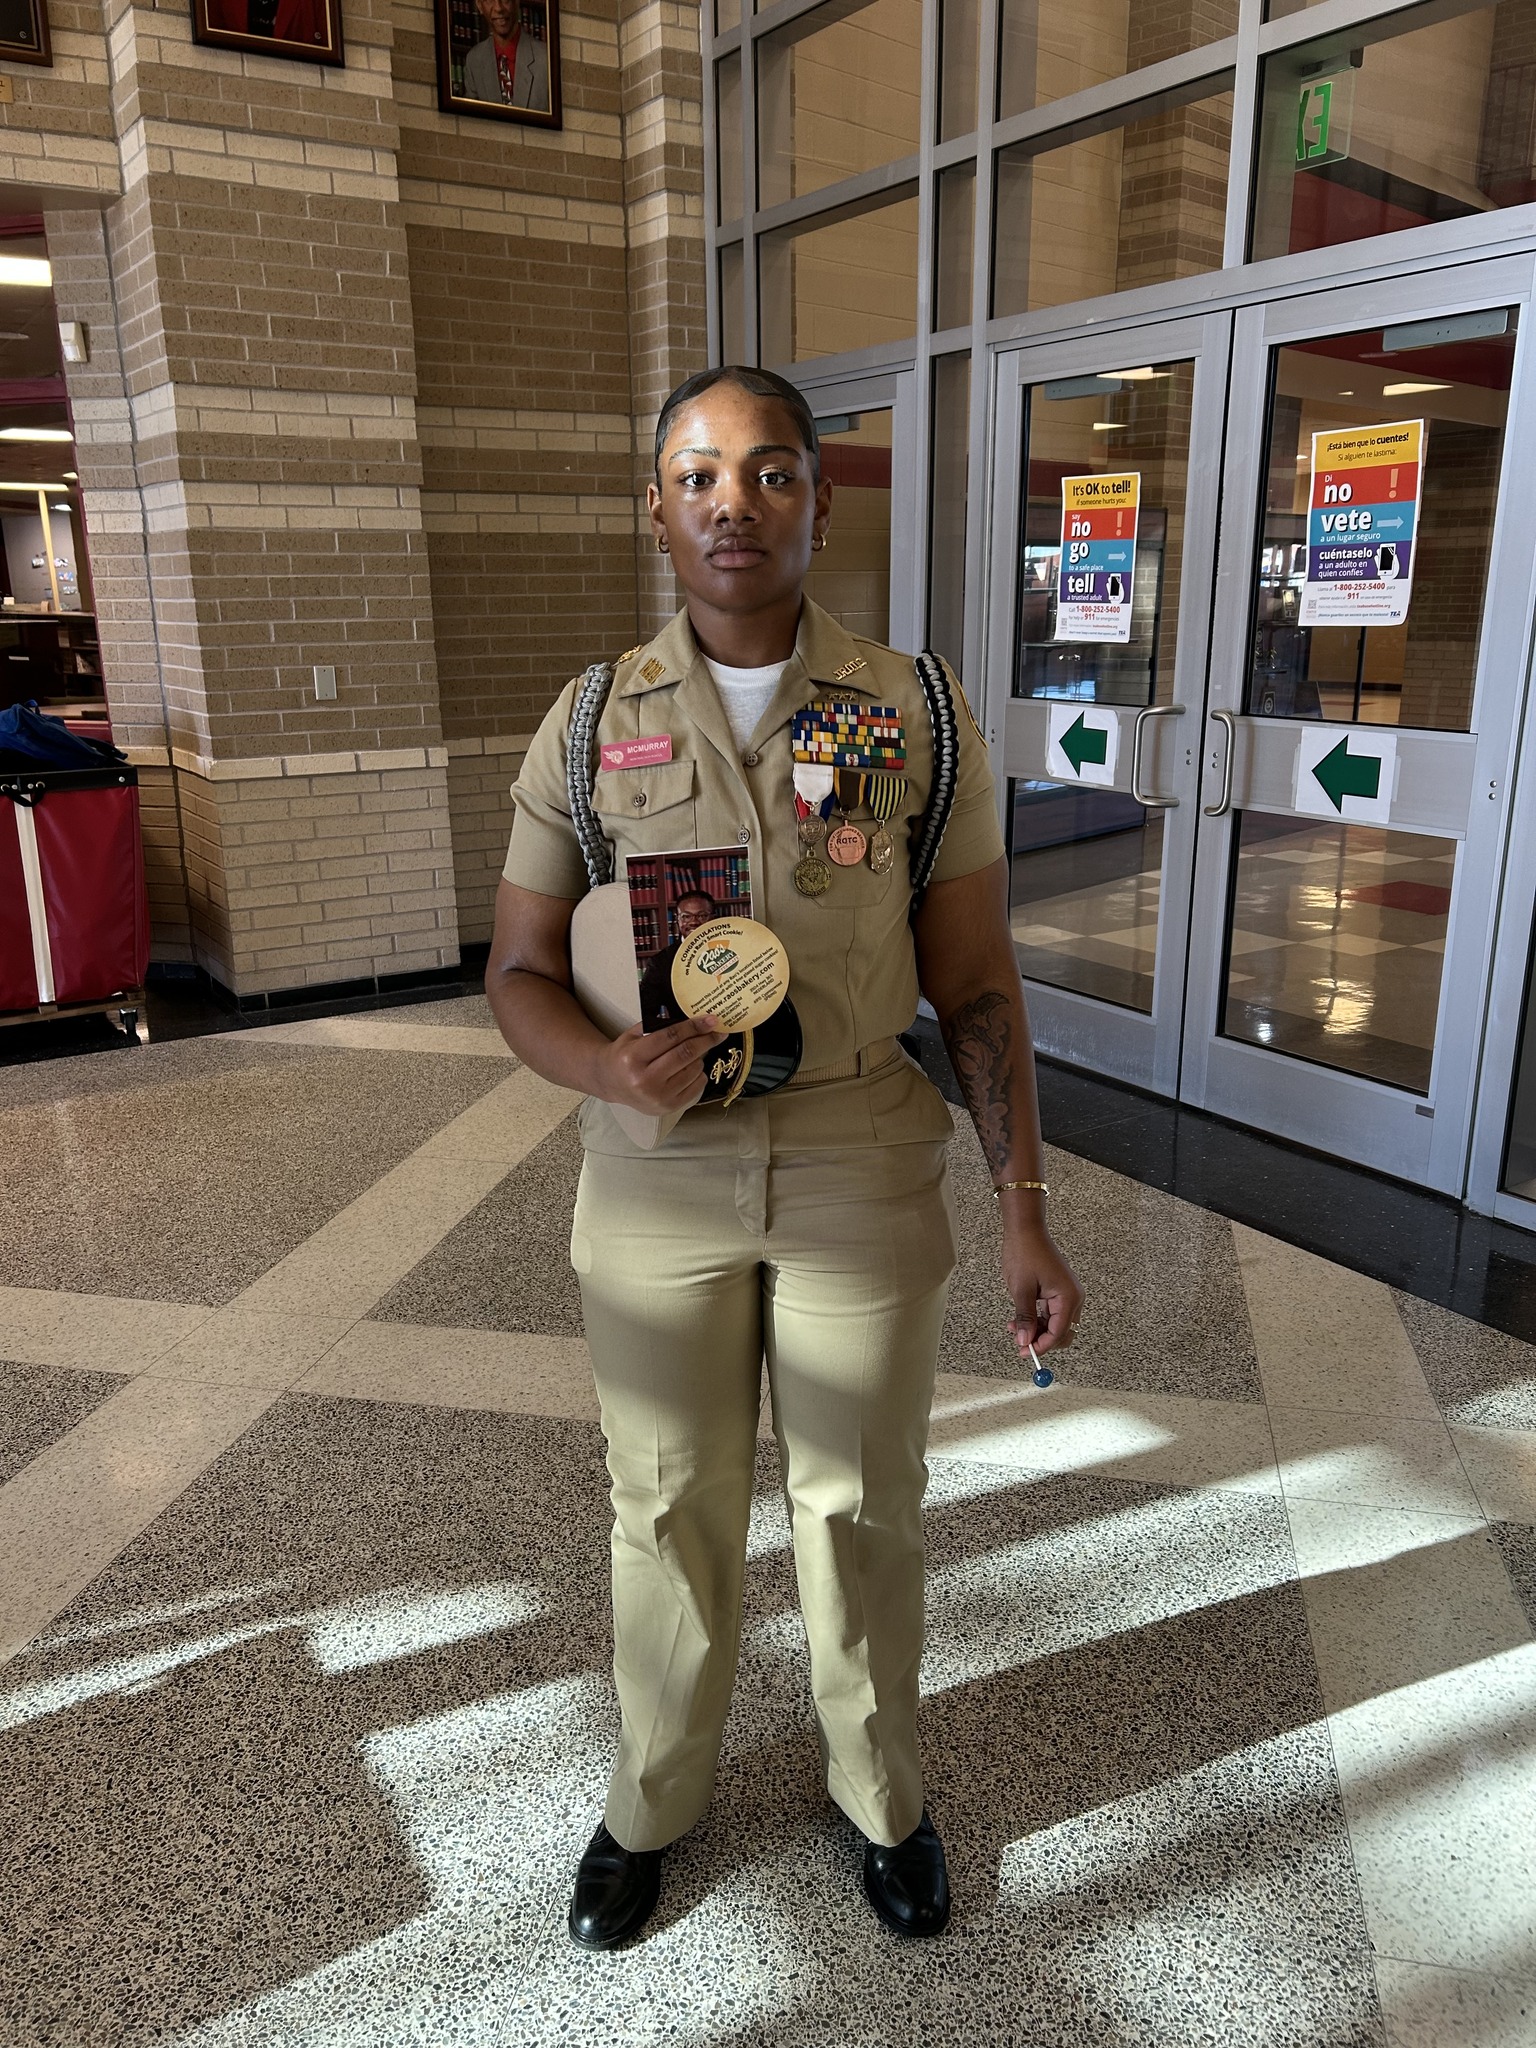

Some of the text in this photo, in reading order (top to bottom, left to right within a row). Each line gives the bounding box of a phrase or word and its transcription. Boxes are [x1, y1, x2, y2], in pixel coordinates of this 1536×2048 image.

[1327, 442, 1342, 452] ¡Está
[1357, 440, 1368, 448] que
[1376, 432, 1409, 444] cuentes!
[1344, 452, 1365, 462] alguien
[1086, 482, 1100, 495] OK
[1101, 484, 1110, 494] to
[1112, 480, 1131, 494] tell!
[1324, 483, 1352, 504] no
[1071, 521, 1092, 538] no
[1321, 510, 1372, 533] vete
[1337, 534, 1355, 543] lugar
[1356, 533, 1380, 542] seguro
[1069, 542, 1090, 564] go
[1319, 547, 1373, 560] cuéntaselo
[1335, 560, 1357, 568] adulto
[1318, 568, 1364, 579] quien confíes
[1068, 573, 1095, 594] tell
[627, 740, 668, 754] MCMURRAY
[836, 836, 858, 845] ROTC
[681, 924, 731, 962] CONGRATULATIONS
[707, 932, 722, 940] Smart
[698, 944, 725, 973] Rao's
[710, 952, 734, 972] BAKERY
[706, 962, 775, 1014] www.raosbakery.com
